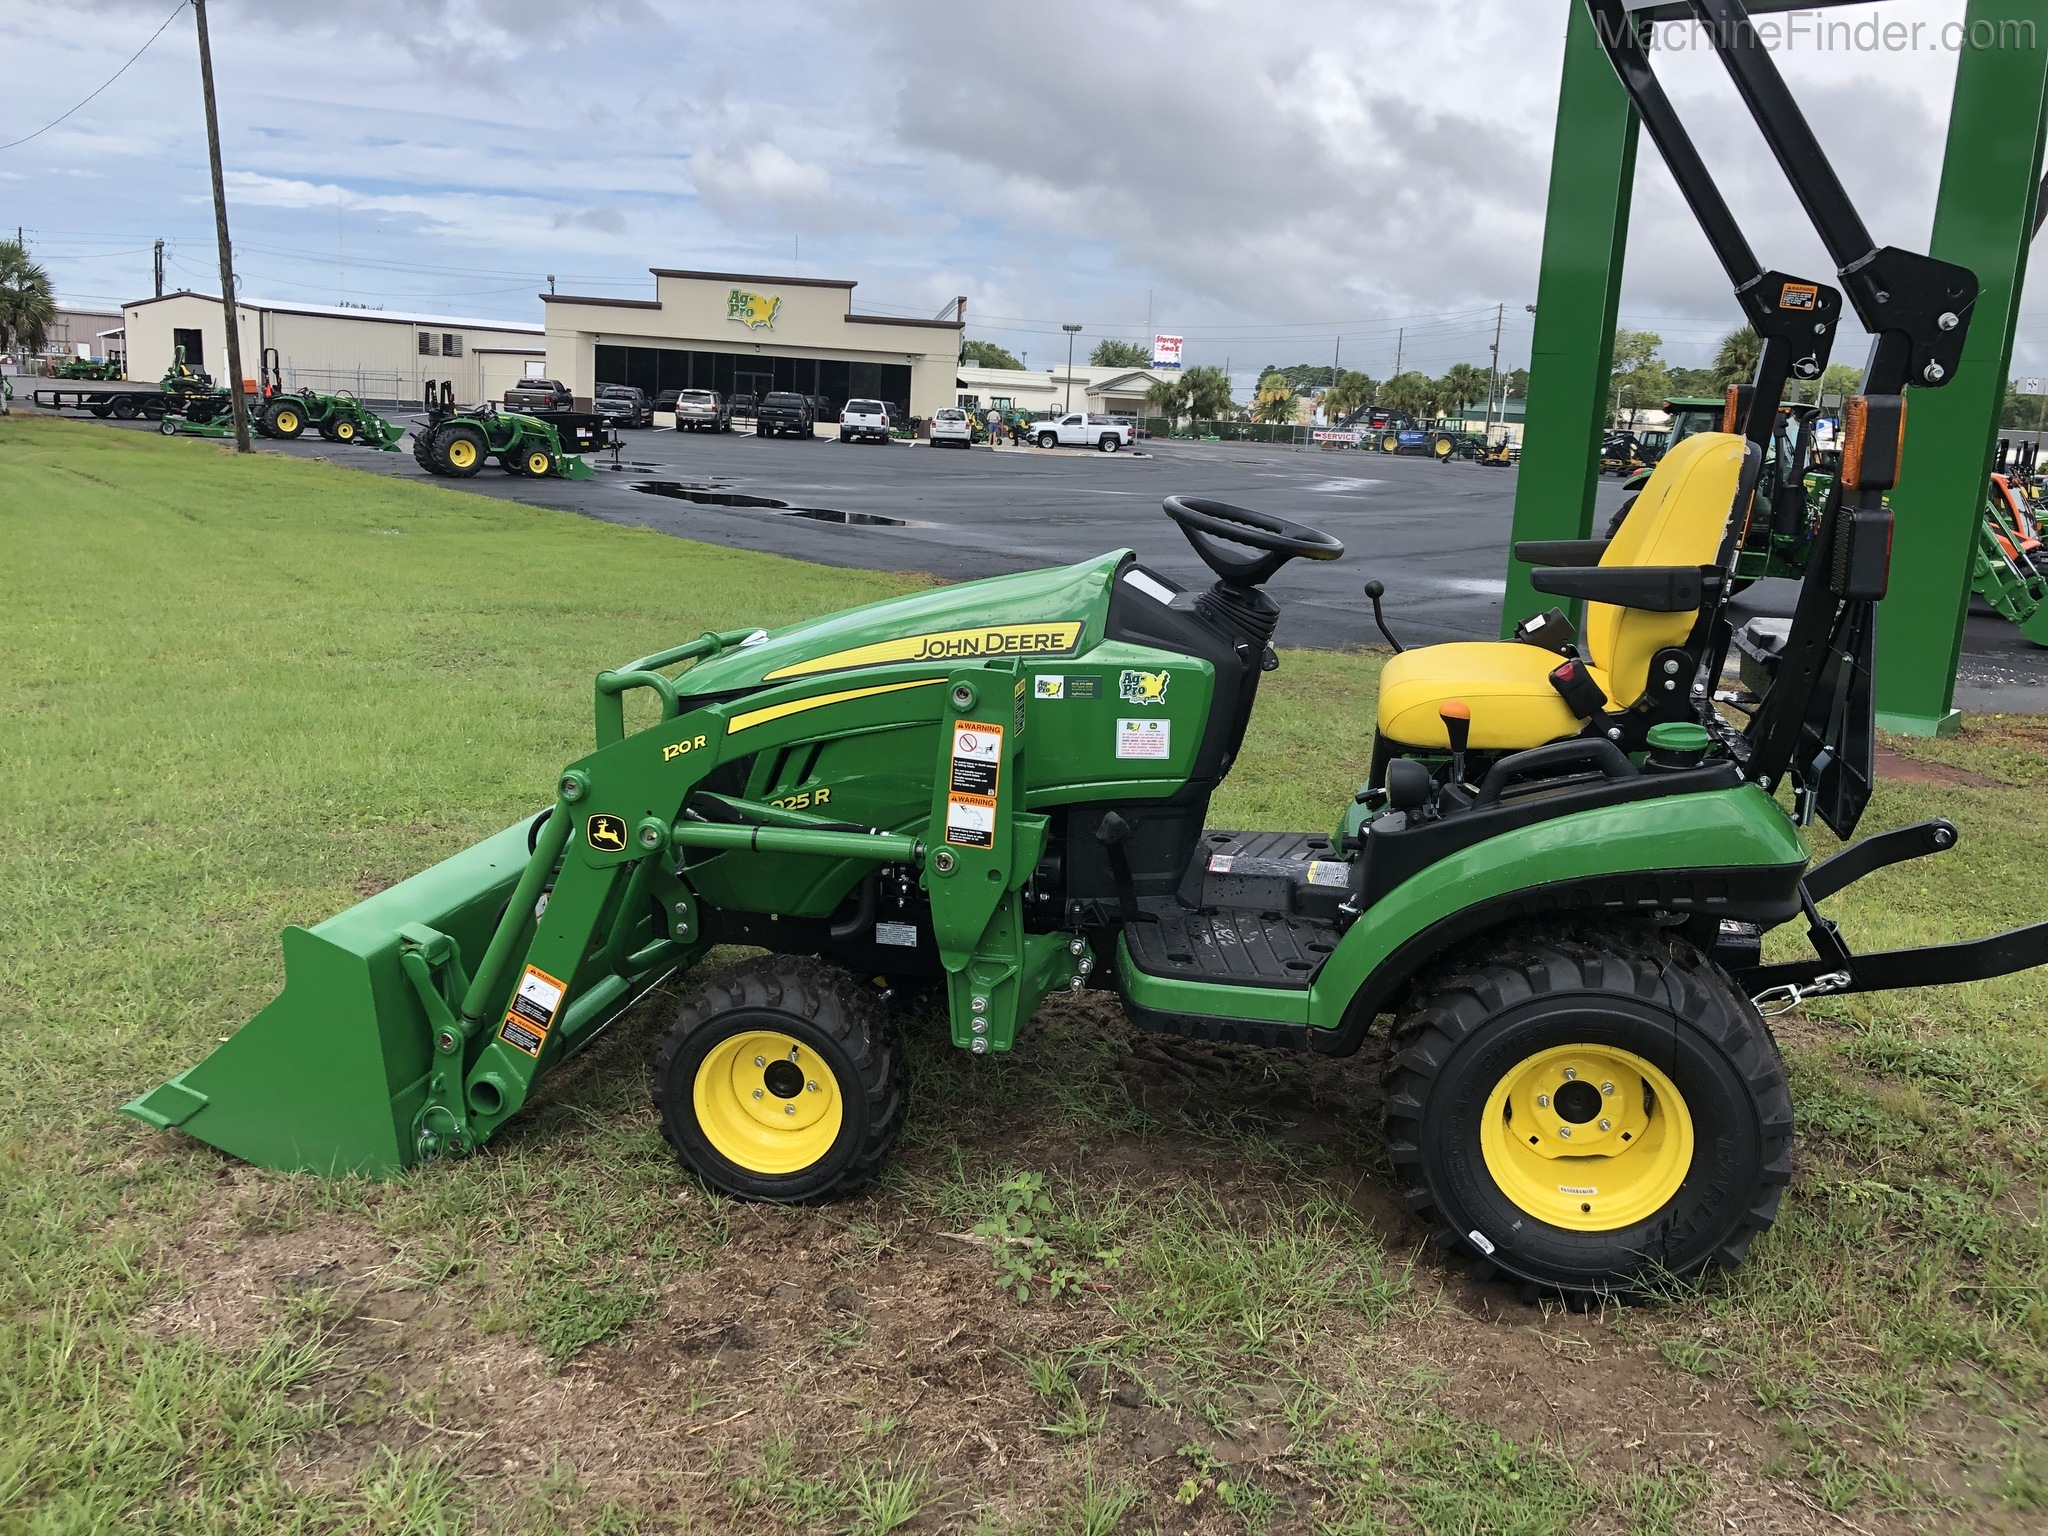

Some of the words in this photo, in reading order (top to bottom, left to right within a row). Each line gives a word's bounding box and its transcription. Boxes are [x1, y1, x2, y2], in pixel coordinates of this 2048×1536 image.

[728, 290, 755, 307] Ag-
[728, 303, 755, 317] Pro
[1156, 335, 1183, 346] Storage
[1322, 432, 1356, 441] SERVICE
[914, 637, 979, 658] JOHN
[985, 633, 1065, 652] DEERE
[1122, 672, 1146, 686] Ag-
[1122, 684, 1146, 696] Pro
[964, 722, 1000, 734] WARNING
[662, 740, 692, 762] 120
[694, 735, 708, 750] R
[815, 788, 832, 806] R
[958, 795, 994, 807] WARNING
[536, 972, 562, 988] WARNING
[517, 1019, 542, 1036] WARNING
